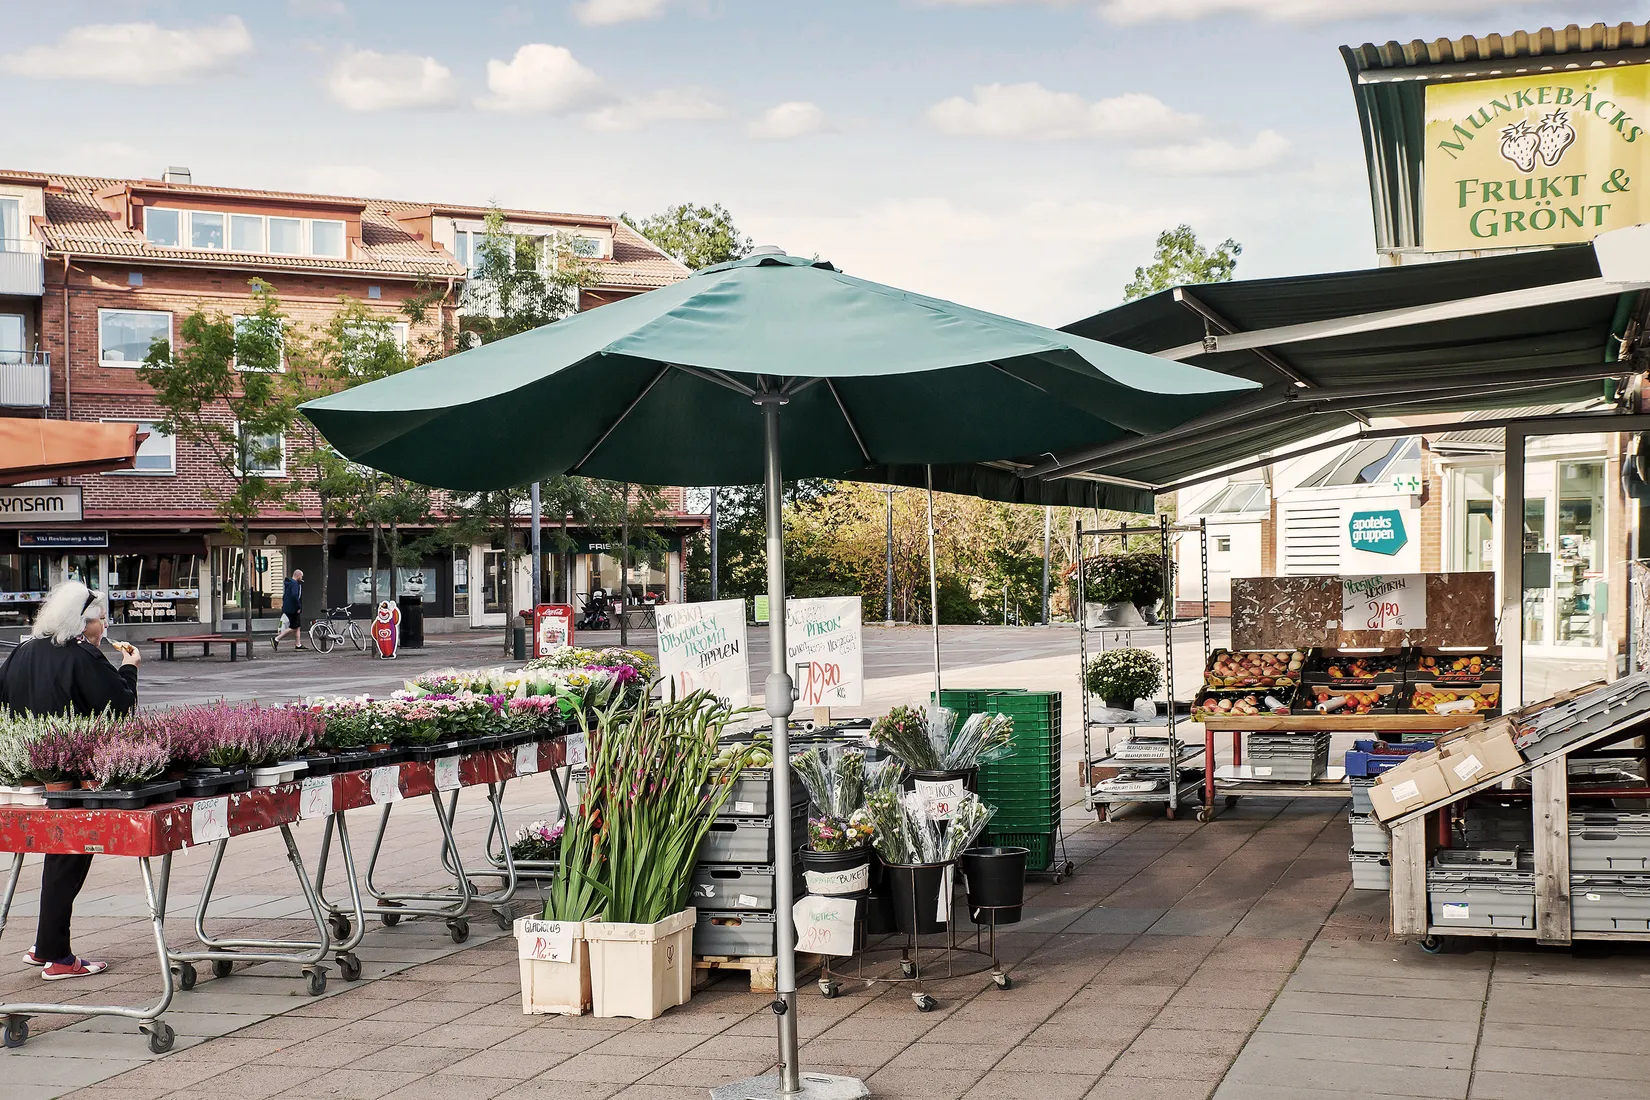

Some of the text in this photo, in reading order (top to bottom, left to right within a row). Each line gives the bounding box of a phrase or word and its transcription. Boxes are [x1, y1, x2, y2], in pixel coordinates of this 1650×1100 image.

[1437, 84, 1643, 159] MUNKEBÄCKS
[1455, 168, 1631, 208] FRUKT &
[1470, 200, 1612, 238] GRÖNT
[0, 496, 64, 512] YNSAM
[1352, 516, 1392, 531] apoteks
[1352, 529, 1395, 543] gruppen
[697, 639, 740, 668] ÄPPLEN
